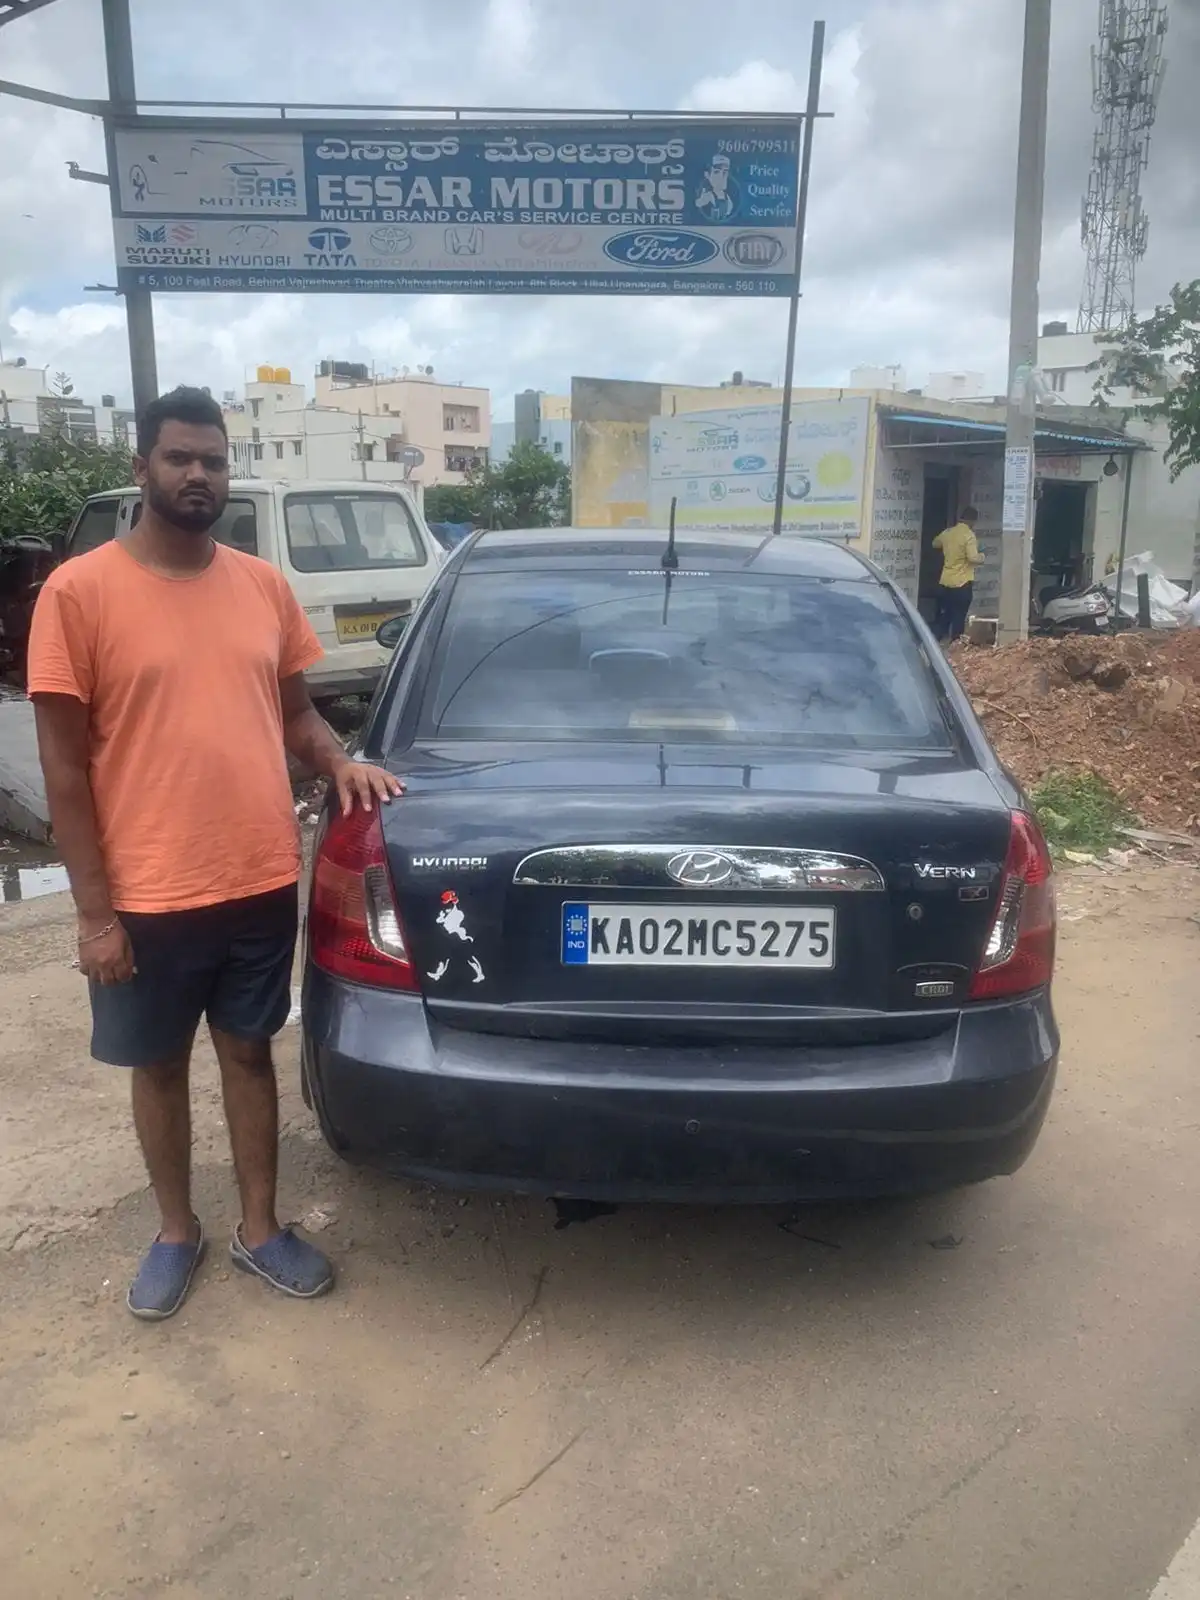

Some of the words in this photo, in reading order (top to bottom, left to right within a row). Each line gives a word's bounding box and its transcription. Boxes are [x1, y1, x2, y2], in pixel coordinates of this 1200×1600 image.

[749, 164, 780, 177] Price
[316, 174, 474, 208] ESSAR
[490, 177, 685, 210] MOTORS
[747, 183, 790, 199] Quality
[199, 197, 298, 208] MOTORS
[320, 209, 376, 222] MULTI
[382, 210, 450, 223] BRAND
[455, 210, 515, 224] CAR'S
[519, 211, 602, 224] SERVICE
[607, 212, 684, 225] CENTRE
[749, 203, 793, 217] Service
[125, 246, 211, 256] MARUTI
[626, 234, 697, 262] Ford
[737, 241, 774, 261] FIAT
[126, 255, 211, 266] SUZUKI
[217, 255, 291, 267] HYUNDAI
[303, 253, 358, 267] TATA
[163, 276, 184, 286] 100
[249, 276, 286, 288] Behind
[673, 279, 725, 292] Bangalore
[735, 280, 755, 292] 560
[590, 917, 831, 958] KA02MC5275
[567, 940, 586, 950] IND
